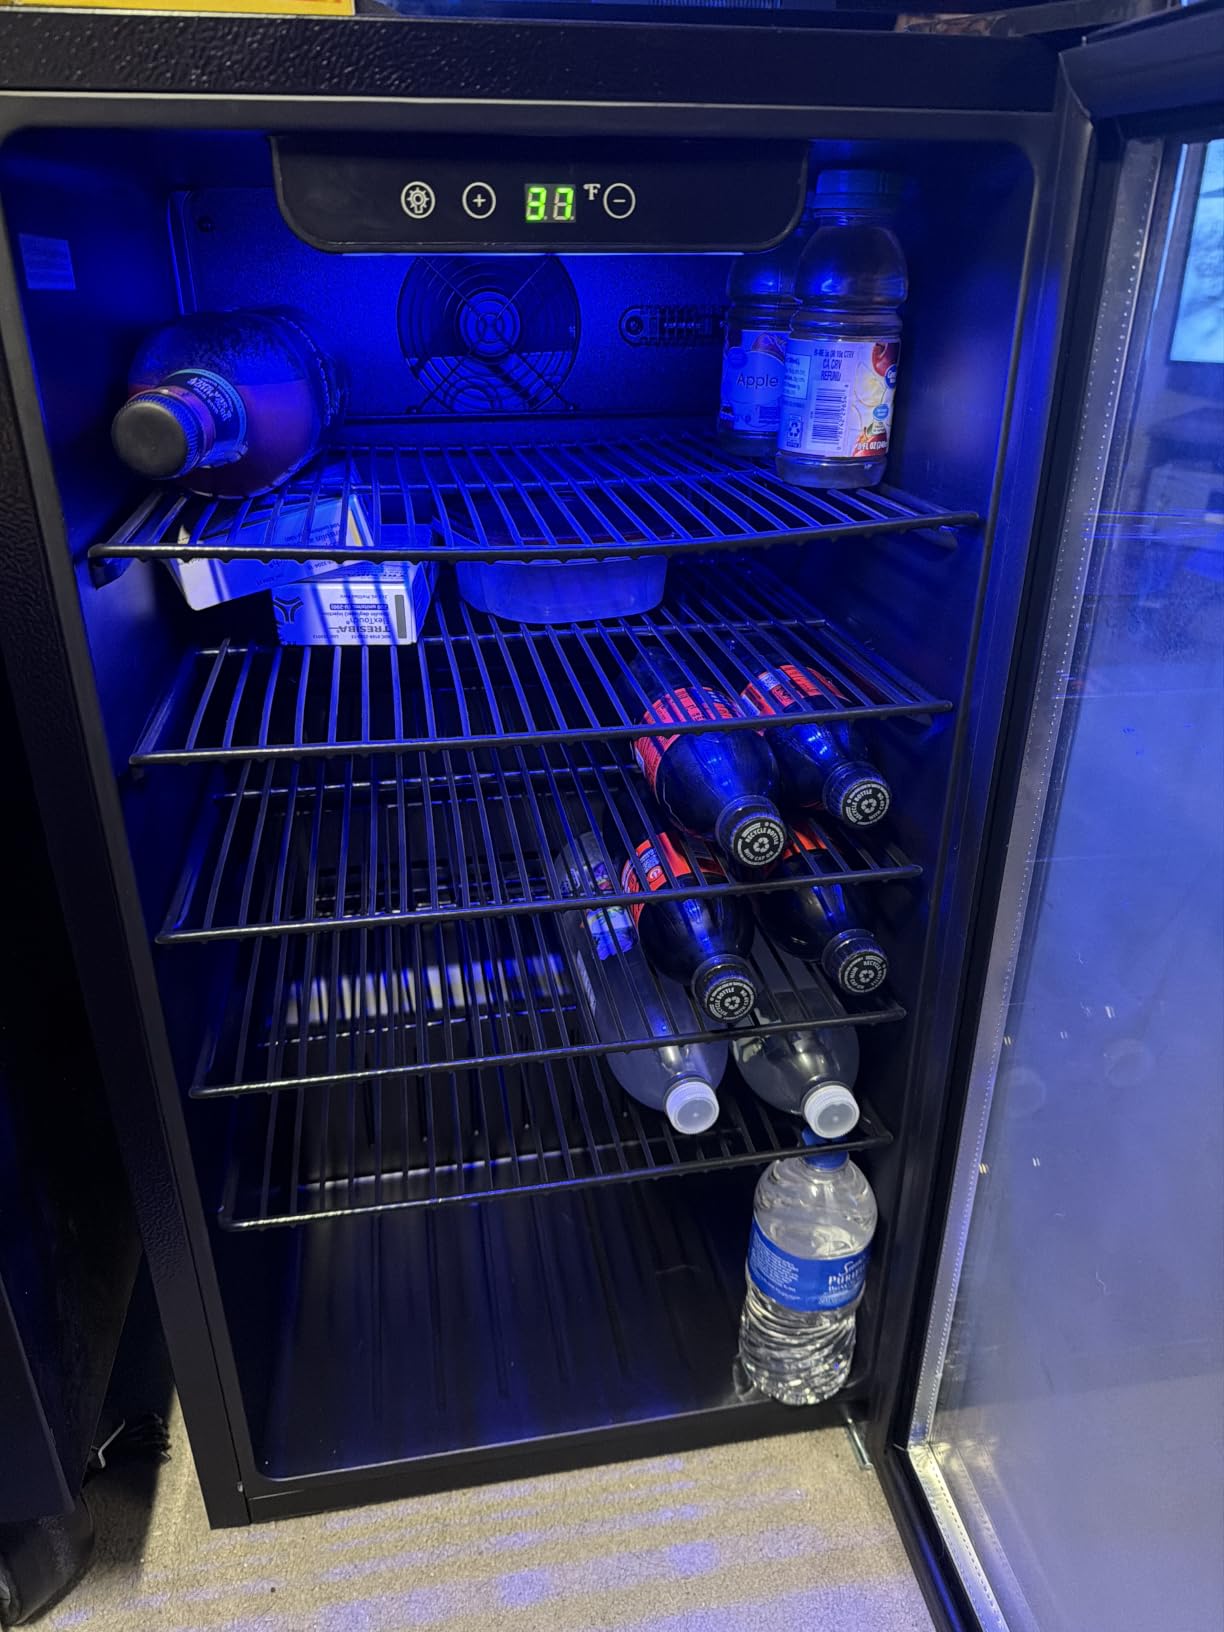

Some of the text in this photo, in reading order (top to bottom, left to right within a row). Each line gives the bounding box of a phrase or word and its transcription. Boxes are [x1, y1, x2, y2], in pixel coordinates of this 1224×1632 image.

[525, 187, 575, 221] 37
[737, 373, 779, 390] Apple
[745, 827, 779, 845] RECYCLE BOTTLE
